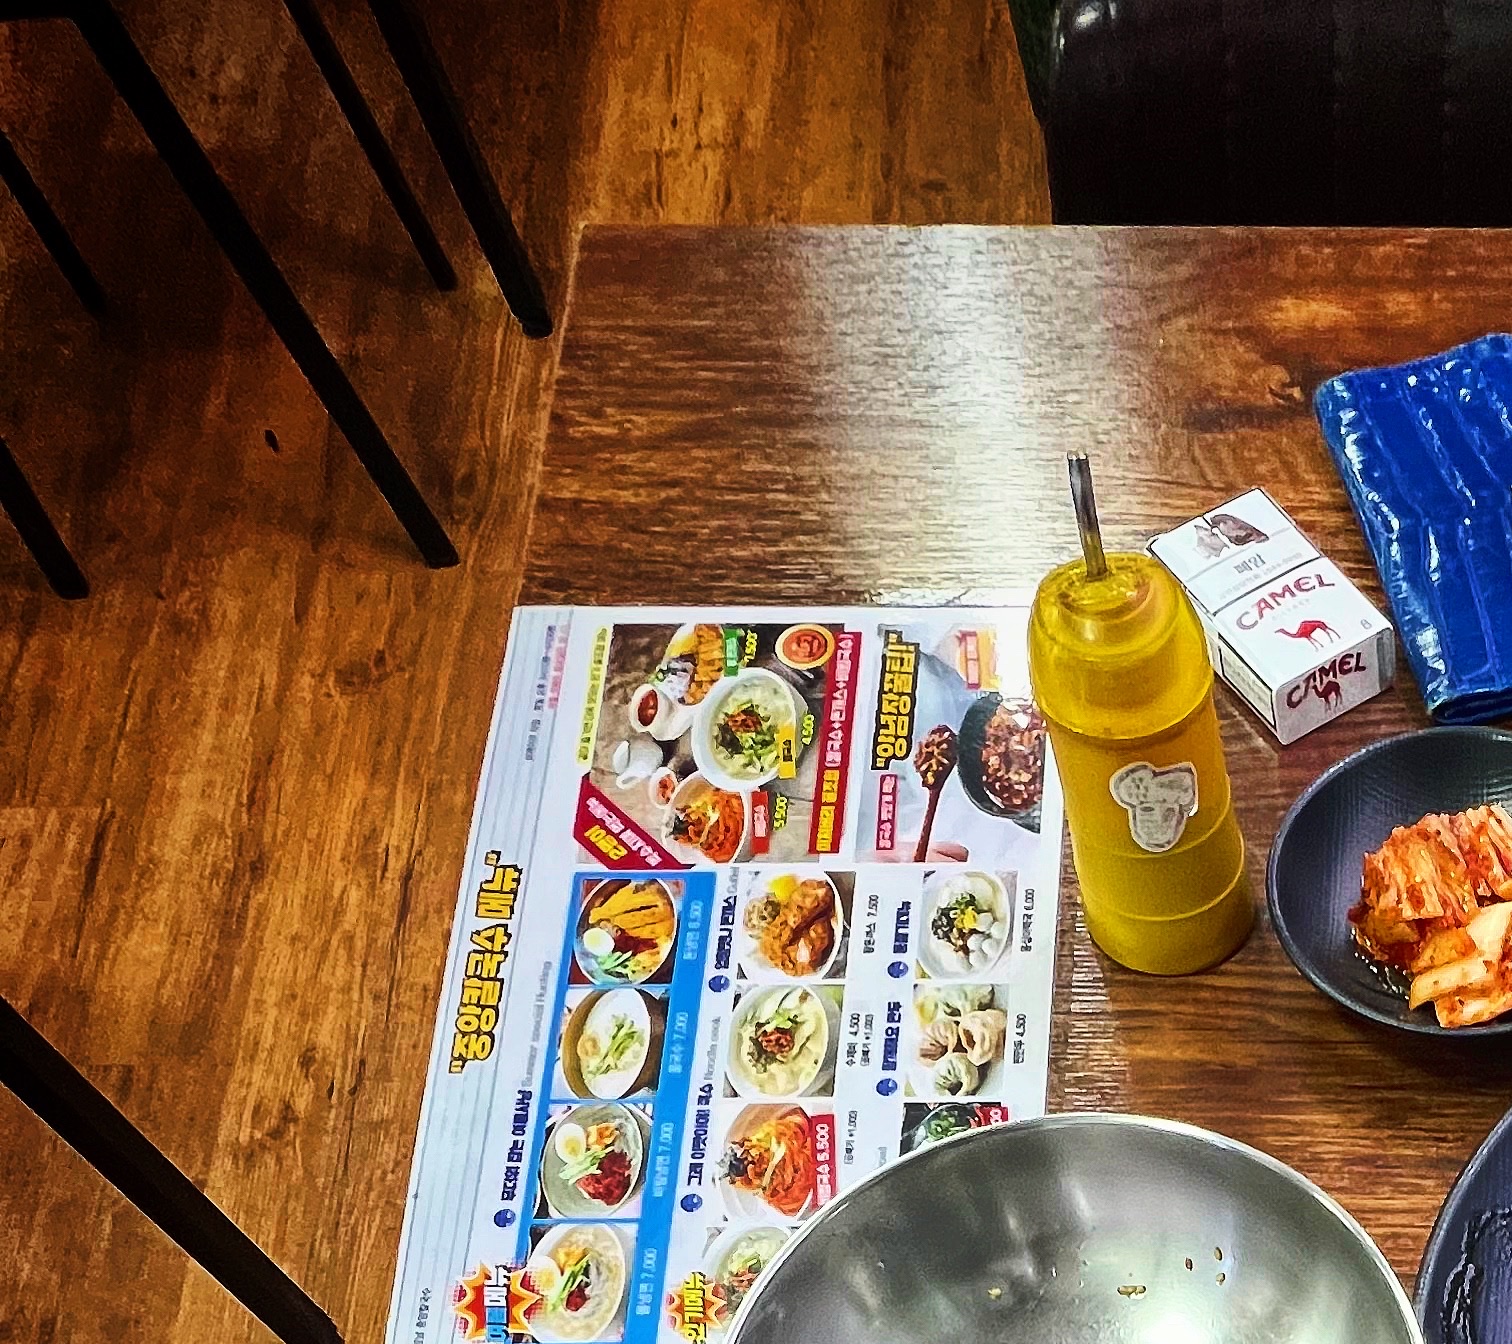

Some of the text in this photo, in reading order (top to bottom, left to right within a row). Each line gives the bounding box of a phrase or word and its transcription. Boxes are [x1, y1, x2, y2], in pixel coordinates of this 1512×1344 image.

[1236, 573, 1336, 632] CAMEL
[1286, 651, 1367, 710] CAMEL
[680, 1270, 708, 1342] 인기메뉴
